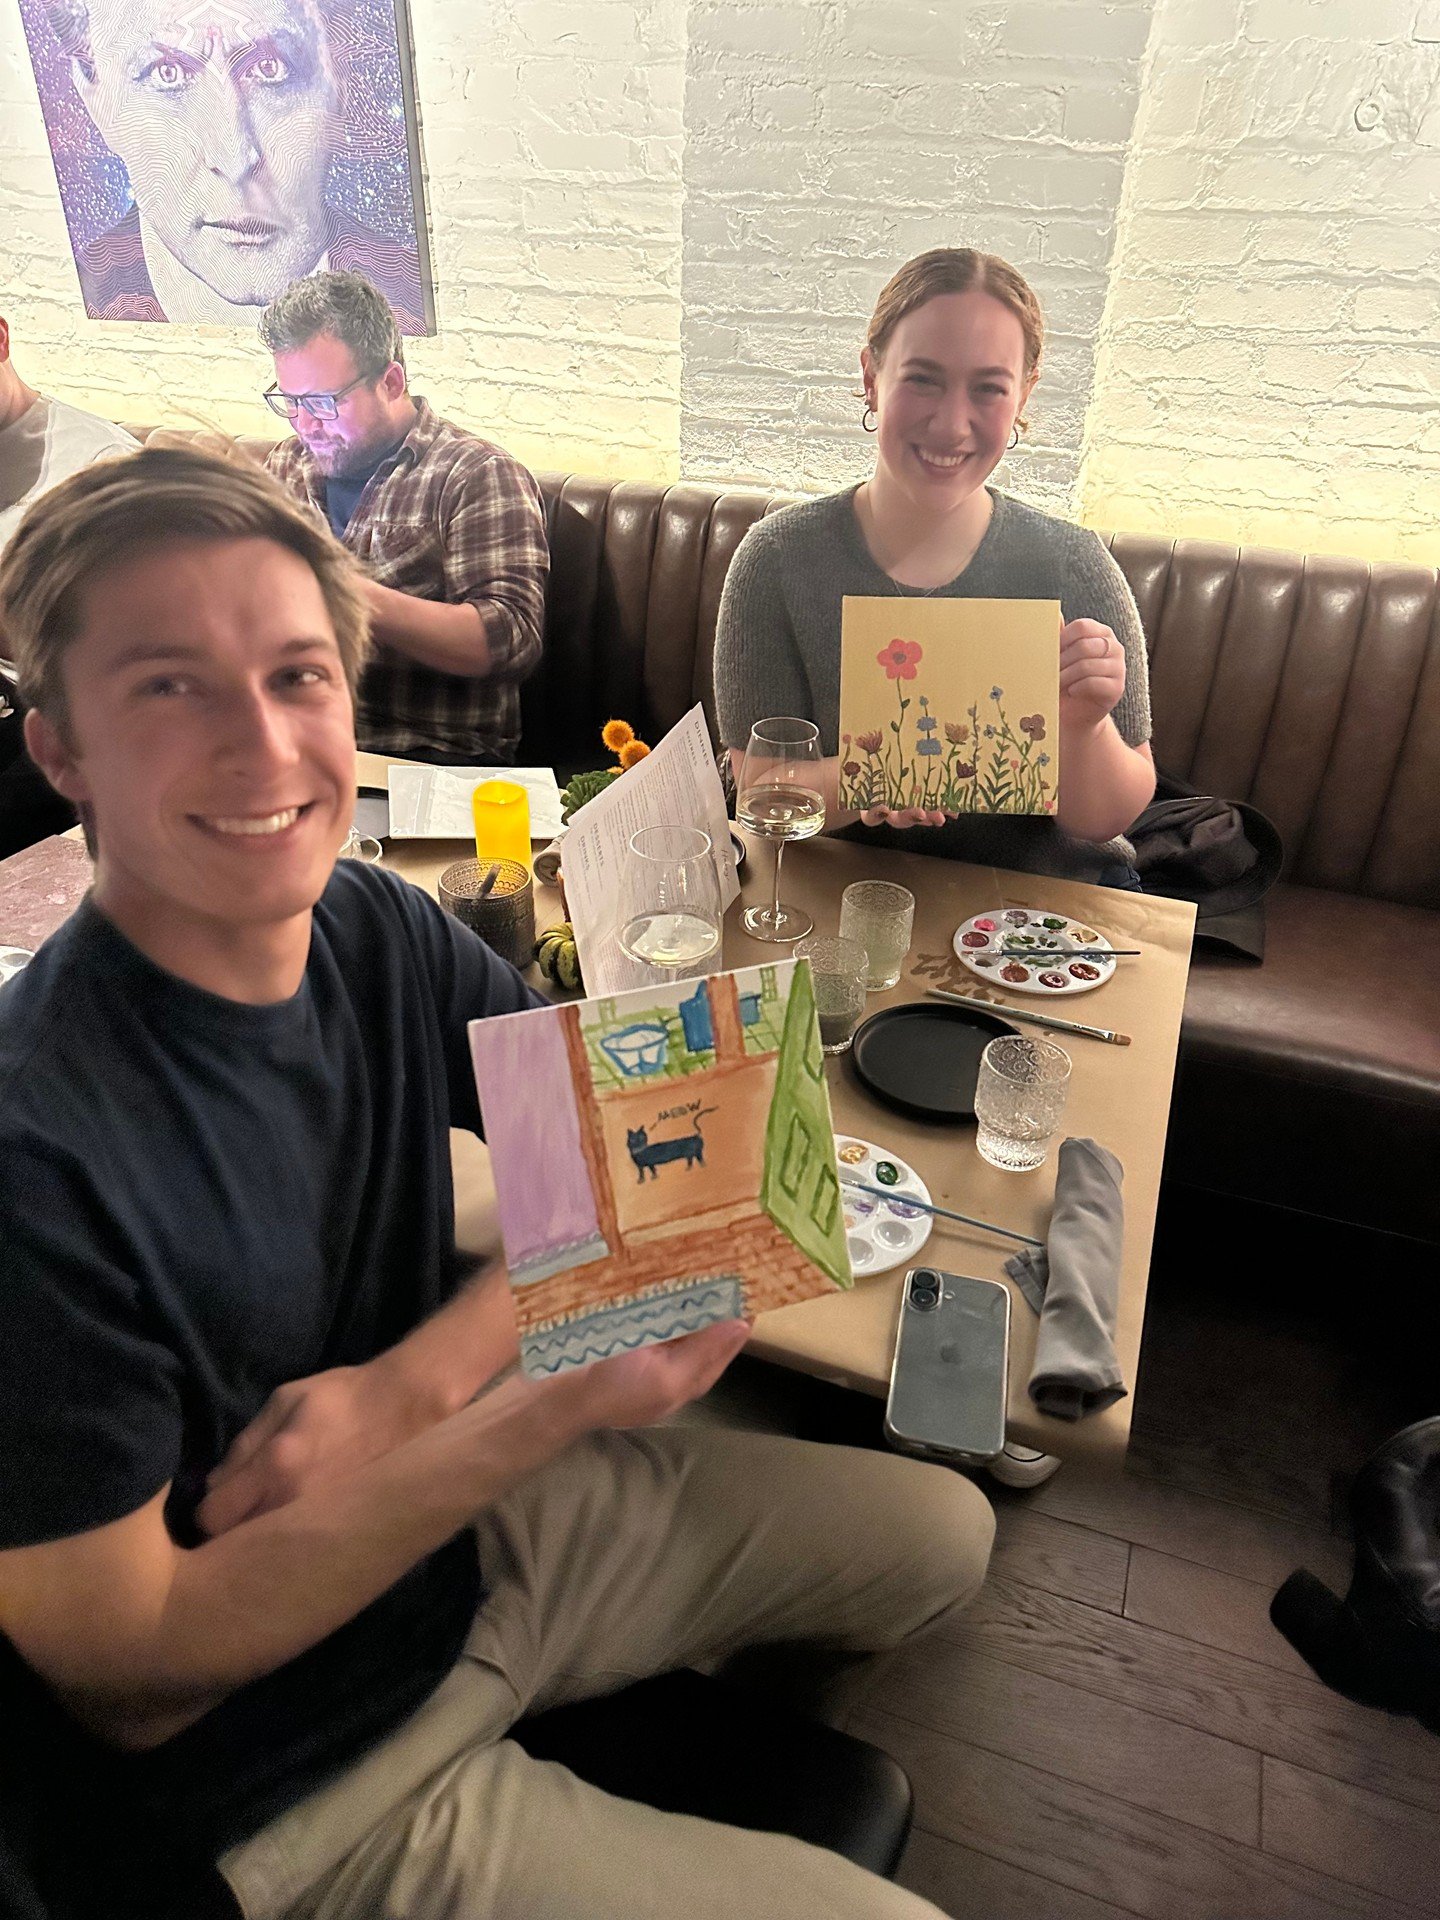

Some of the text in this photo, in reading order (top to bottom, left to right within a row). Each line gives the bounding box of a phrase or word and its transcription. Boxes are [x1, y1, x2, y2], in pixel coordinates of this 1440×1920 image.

[694, 720, 709, 767] DINNER
[580, 835, 590, 870] DRINKS
[593, 822, 604, 867] DESSERTS
[657, 1098, 702, 1121] MEOW
